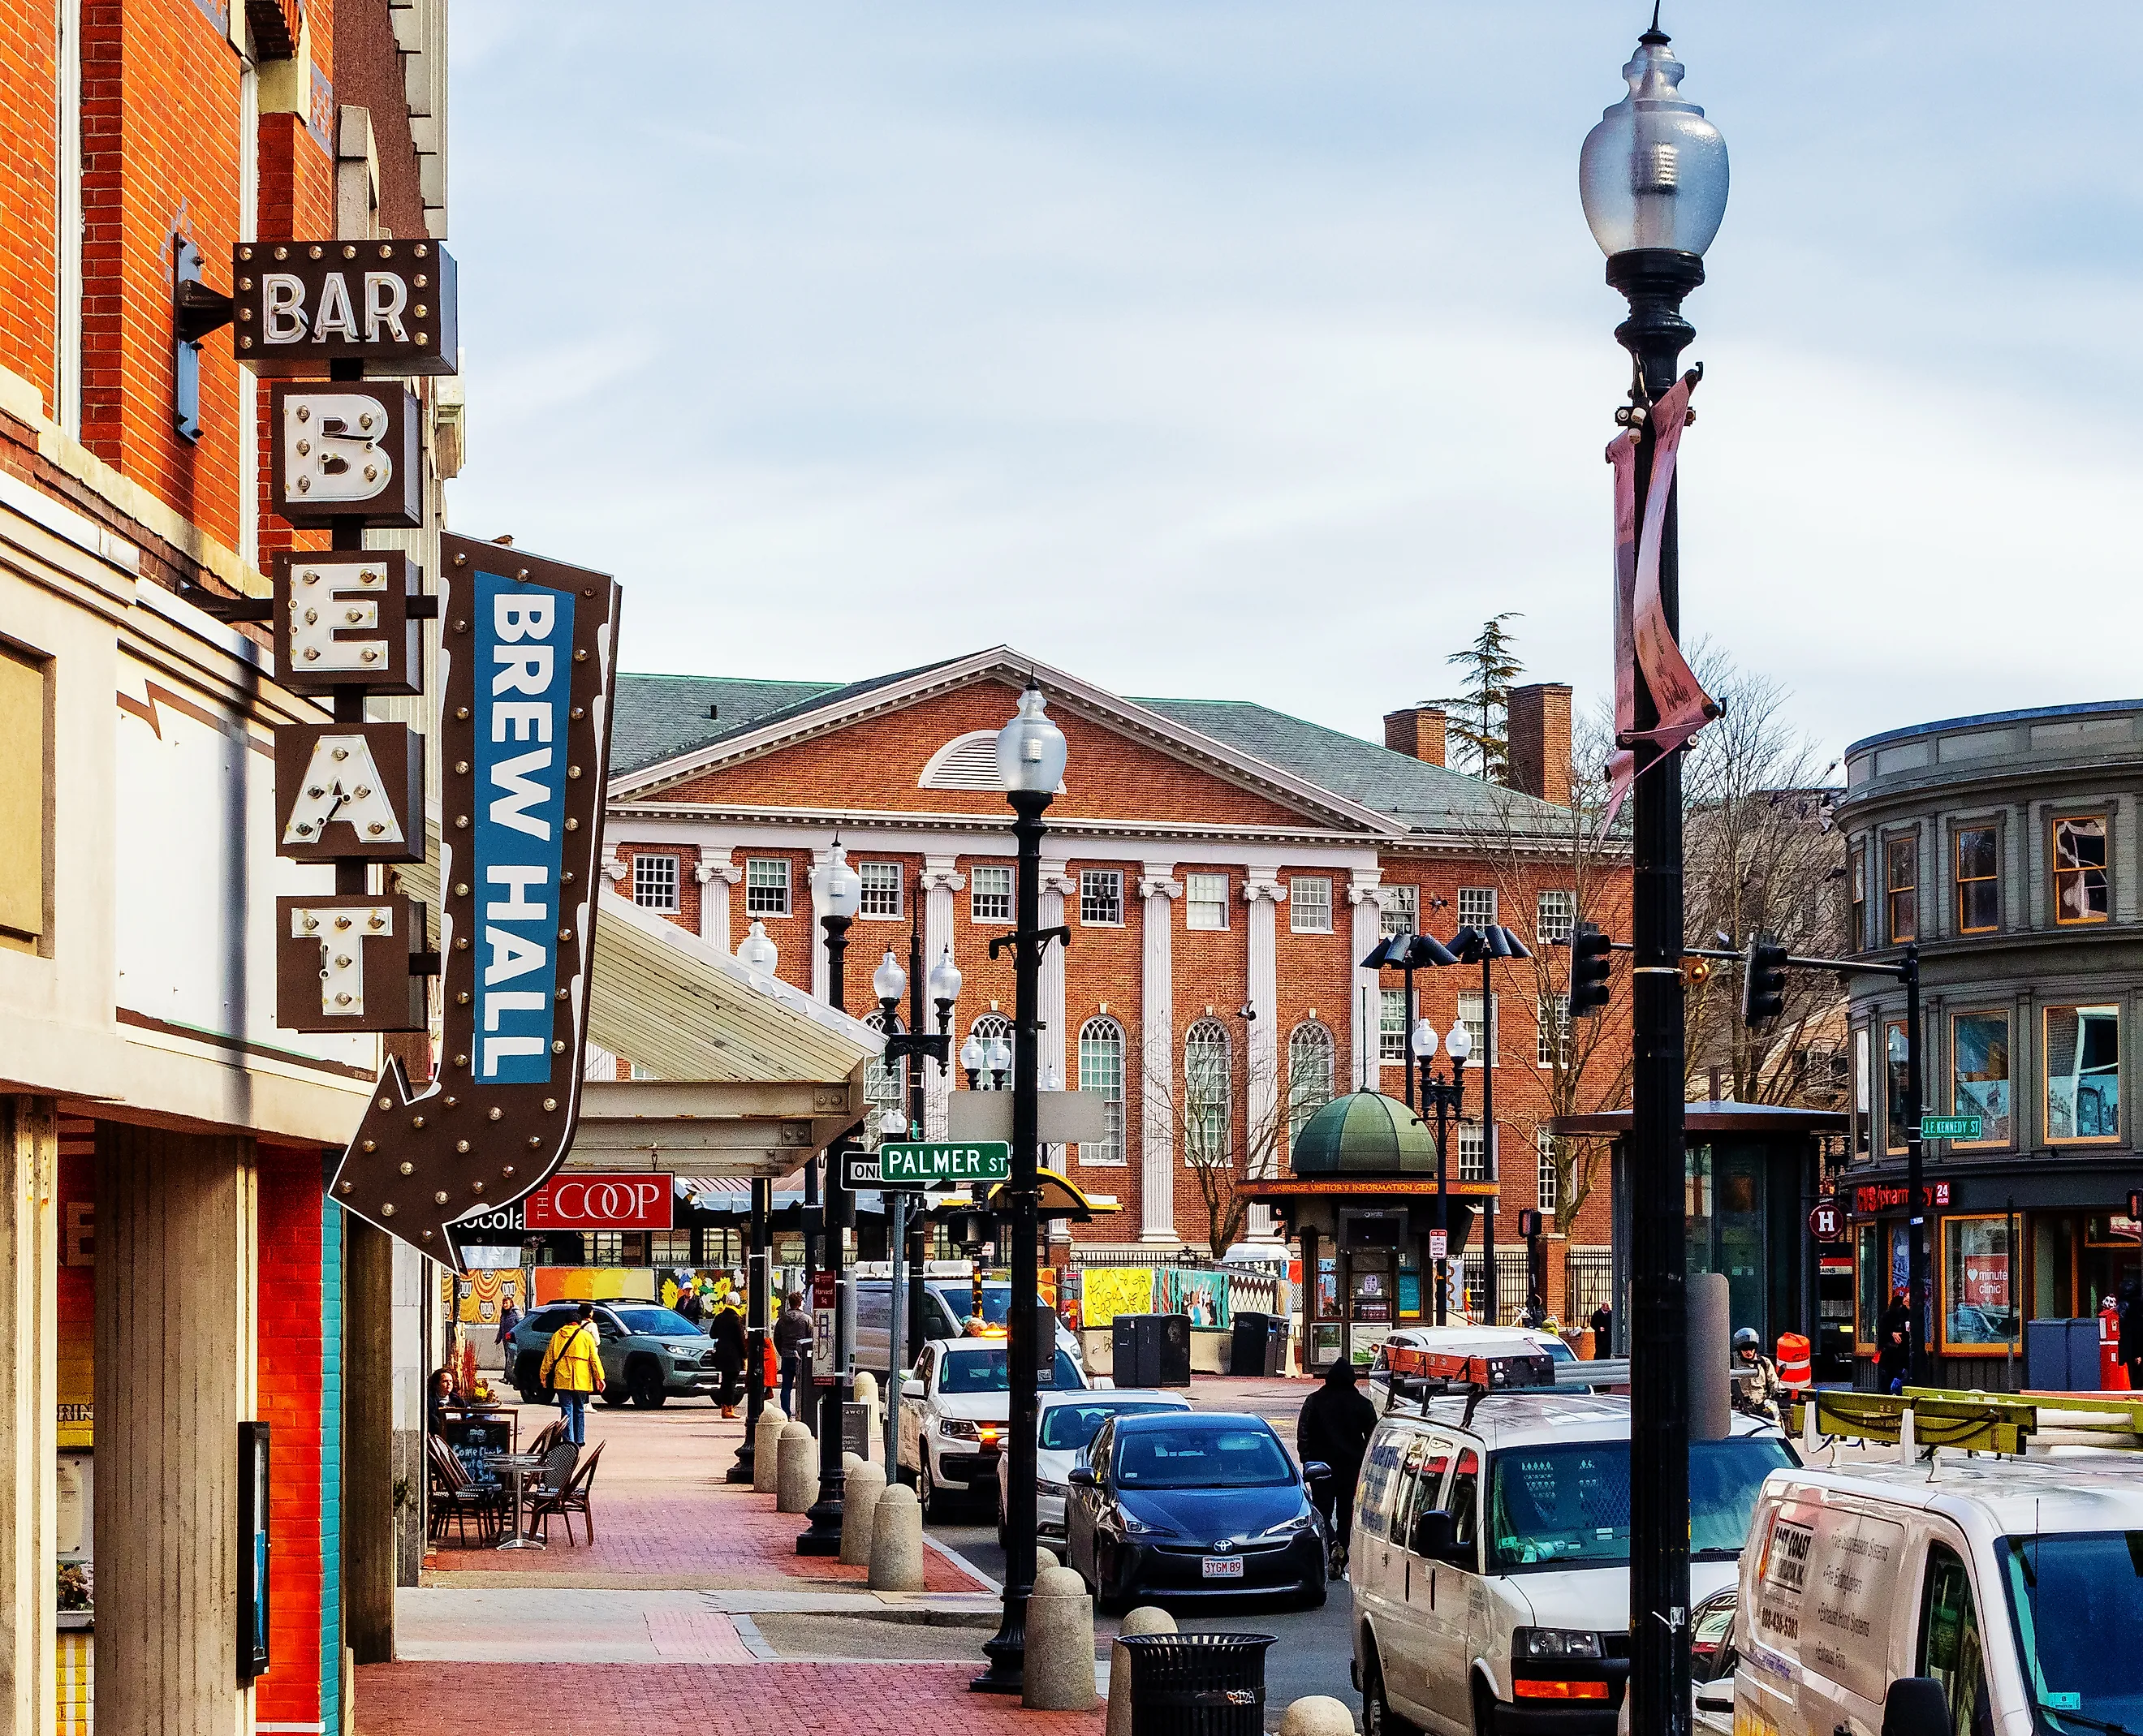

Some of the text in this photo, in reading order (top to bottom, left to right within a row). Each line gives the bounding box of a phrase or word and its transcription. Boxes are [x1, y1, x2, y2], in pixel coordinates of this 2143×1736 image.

[262, 272, 409, 345] BAR
[282, 394, 405, 1015] BEAT
[483, 593, 556, 1078] BREW HALL
[1937, 1121, 1967, 1134] KENNEDY
[1970, 1121, 1979, 1133] ST
[889, 1149, 1006, 1174] PALMER ST
[1266, 1183, 1309, 1192] CAMBRIDGE
[1352, 1183, 1412, 1192] INFORMATION
[1415, 1183, 1438, 1192] CENT
[1937, 1184, 1948, 1197] 24
[554, 1182, 660, 1219] COOP
[1817, 1211, 1835, 1232] H
[1978, 1269, 2008, 1281] minute
[1978, 1282, 2002, 1294] clinic
[453, 1445, 477, 1457] Come
[1205, 1562, 1241, 1573] 3YGM 89
